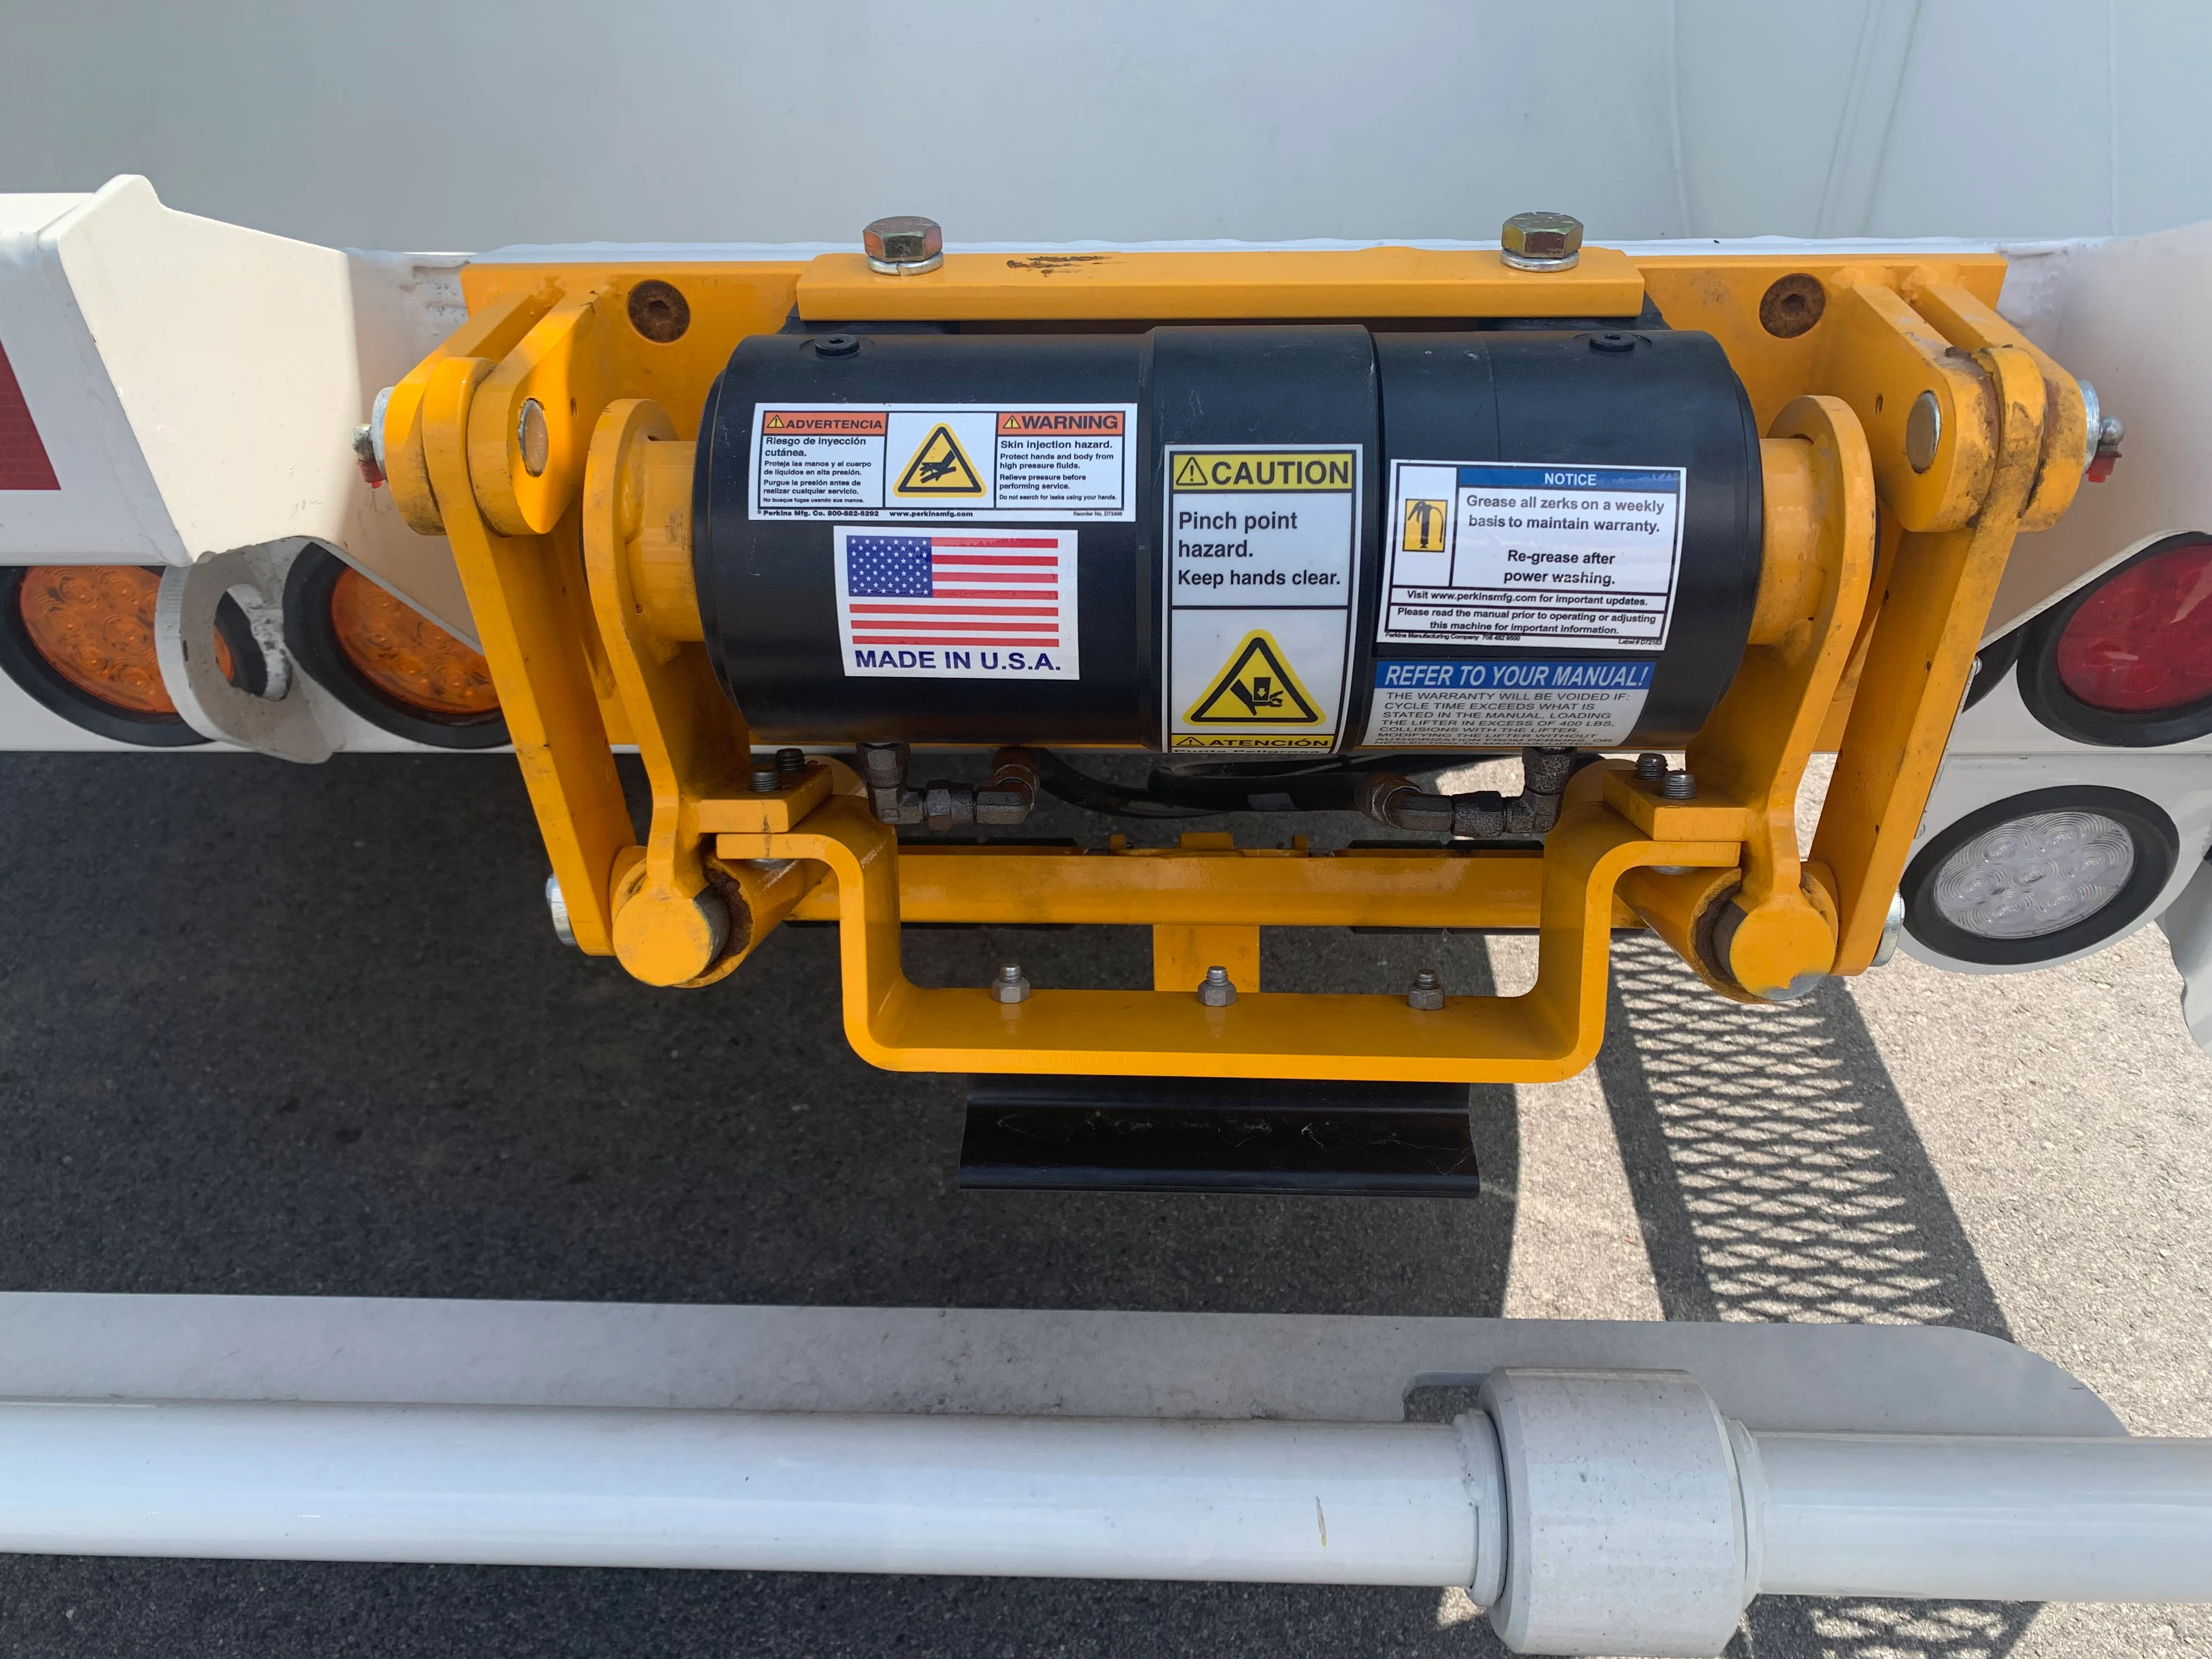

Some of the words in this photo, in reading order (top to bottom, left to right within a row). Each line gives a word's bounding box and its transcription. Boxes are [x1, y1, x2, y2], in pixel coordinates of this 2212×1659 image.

[786, 420, 883, 429] ADVERTENCIA
[1022, 415, 1118, 429] WARNING
[766, 437, 800, 447] Riesgo
[819, 437, 866, 447] inyección
[1001, 441, 1023, 449] Skin
[1027, 441, 1071, 450] injection
[1075, 441, 1113, 449] hazard.
[765, 448, 806, 456] cutánea.
[1211, 461, 1348, 485] CAUTION
[1544, 473, 1596, 486] NOTICE
[1466, 495, 1516, 507] Grease
[1520, 496, 1537, 509] all
[1541, 497, 1578, 510] zerks
[1581, 500, 1598, 511] on
[1603, 501, 1611, 511] a
[1615, 500, 1664, 515] weekly
[1180, 511, 1237, 529] Pinch
[1245, 511, 1297, 534] point
[1469, 515, 1505, 527] basis
[1508, 517, 1522, 528] to
[1526, 517, 1589, 531] maintain
[1594, 520, 1660, 534] warranty.
[1179, 540, 1253, 557] hazard.
[1508, 550, 1578, 566] Re-grease
[1583, 552, 1616, 565] after
[1178, 570, 1223, 589] Keep
[1231, 570, 1285, 585] hands
[1292, 570, 1340, 585] clear.
[1503, 573, 1548, 585] power
[1552, 572, 1615, 586] washing.
[1407, 590, 1429, 599] Visit
[1431, 591, 1536, 603] www.perkinsmfg.com
[1556, 595, 1603, 605] important
[1606, 597, 1647, 606] updates.
[1398, 607, 1429, 616] Please
[1474, 610, 1509, 618] manual
[1511, 611, 1535, 620] prior
[1550, 613, 1596, 623] operating
[1611, 615, 1656, 624] adjusting
[1451, 622, 1492, 630] machine
[1511, 624, 1558, 633] important
[1560, 625, 1619, 634] information.
[855, 650, 936, 669] MADE
[946, 651, 971, 669] IN
[981, 652, 1061, 671] U.S.A.
[1385, 665, 1454, 685] REFER
[1460, 666, 1486, 685] TO
[1492, 666, 1549, 686] YOUR
[1551, 667, 1650, 686] MANUAL!
[1209, 738, 1328, 747] ATENCIÓN
